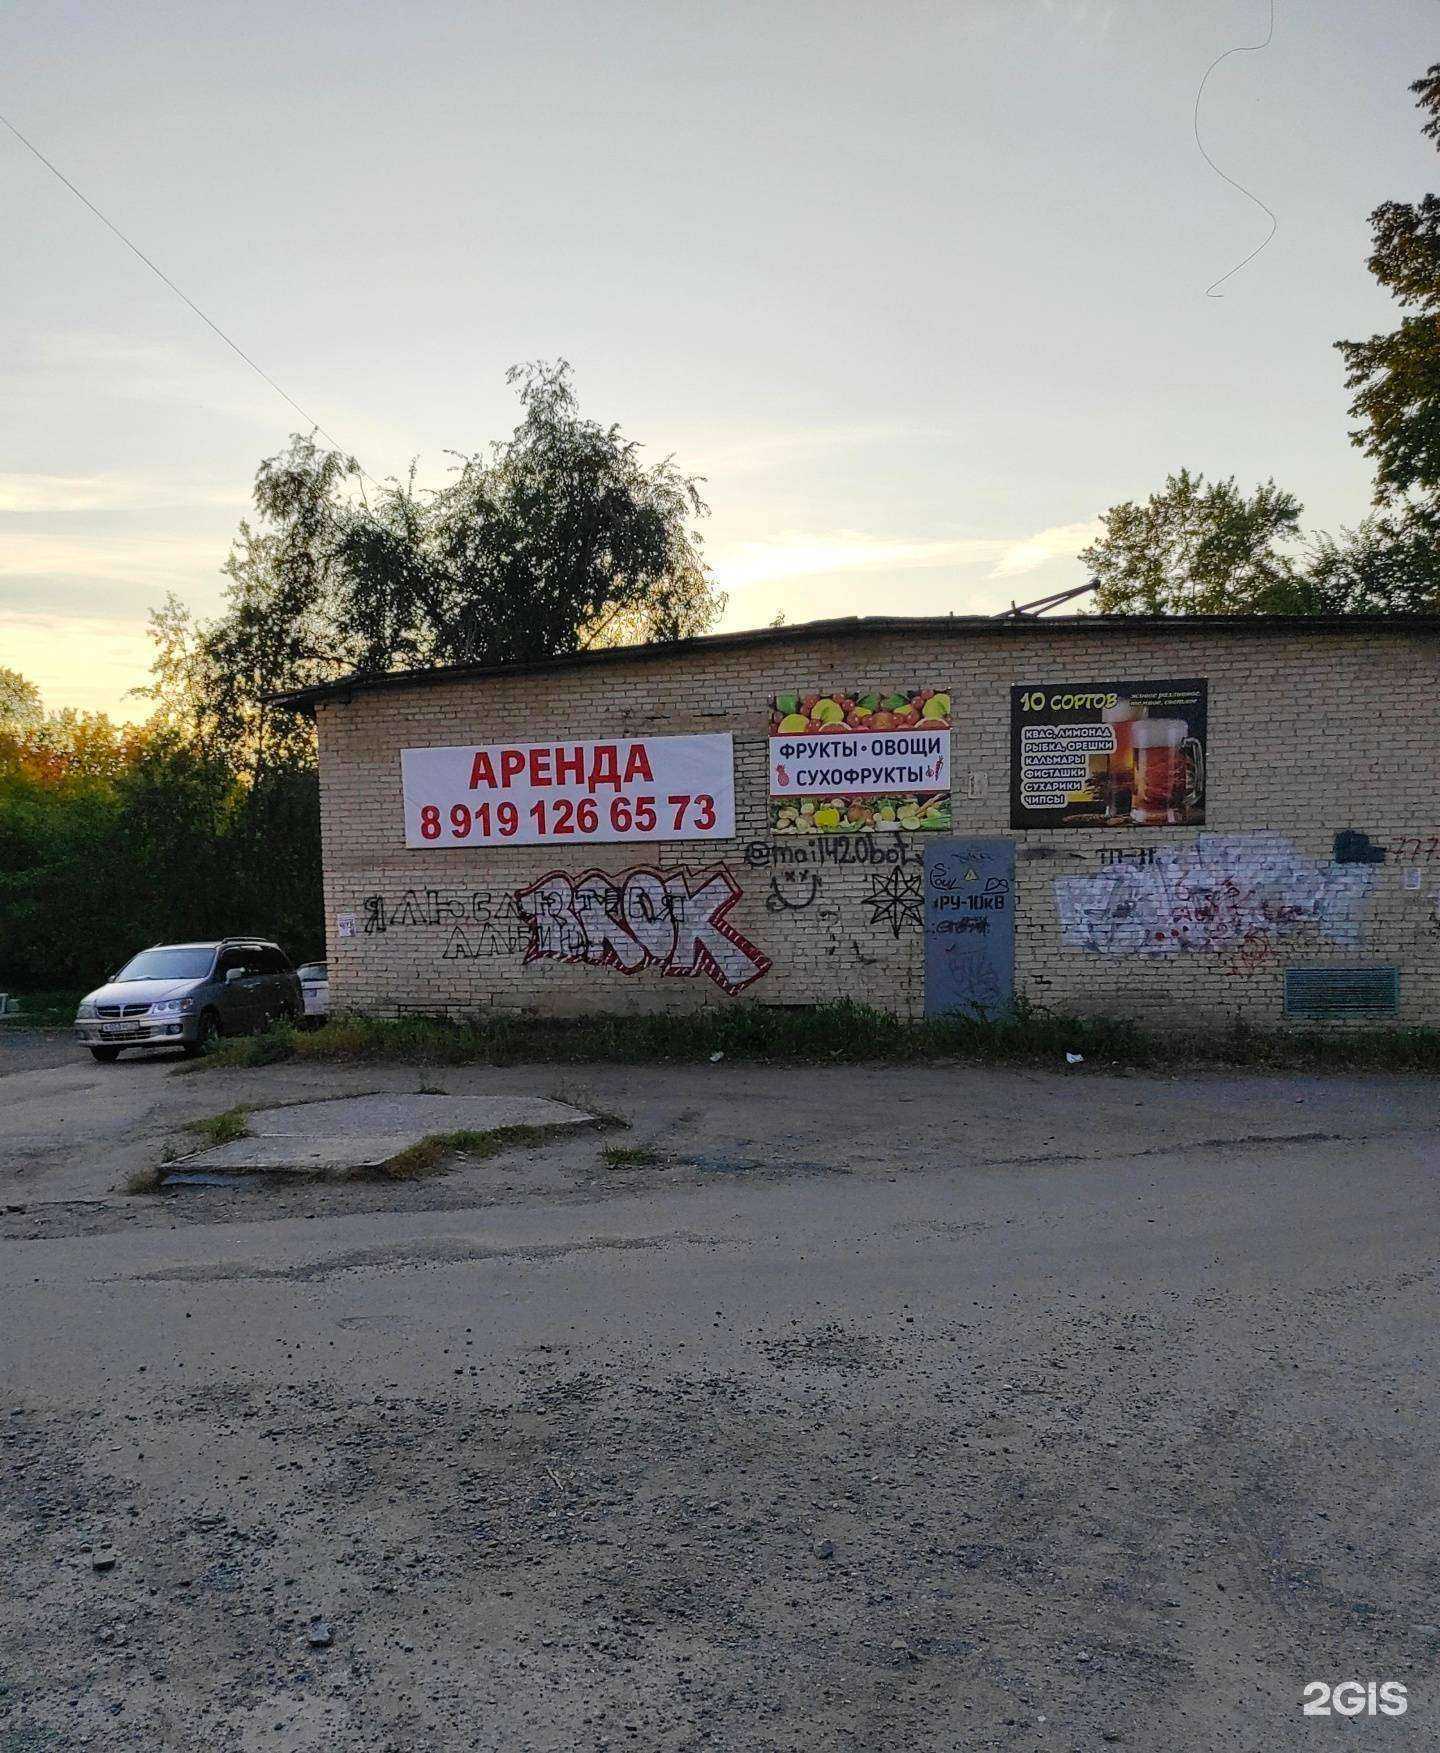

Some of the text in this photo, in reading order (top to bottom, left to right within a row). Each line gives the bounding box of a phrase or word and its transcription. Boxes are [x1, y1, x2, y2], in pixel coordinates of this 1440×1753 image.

[1020, 692, 1118, 711] 10 СОРТОВ
[1025, 727, 1111, 739] КВАС, ЛИМОНАД
[779, 738, 941, 759] ФРУКТЫ ОВОЩИ
[1025, 740, 1113, 753] РЫБКА, ОРЕШКИ
[1025, 754, 1086, 766] КАЛЬМАРЫ
[469, 744, 654, 793] АРЕНДА
[1025, 768, 1086, 779] ФИСТАШКИ
[796, 766, 923, 786] СУХОФРУКТЫ
[1025, 781, 1081, 791] СУХАРИКИ
[1024, 795, 1064, 805] ЧИПСЫ
[420, 794, 717, 840] 8 919 126 65 73
